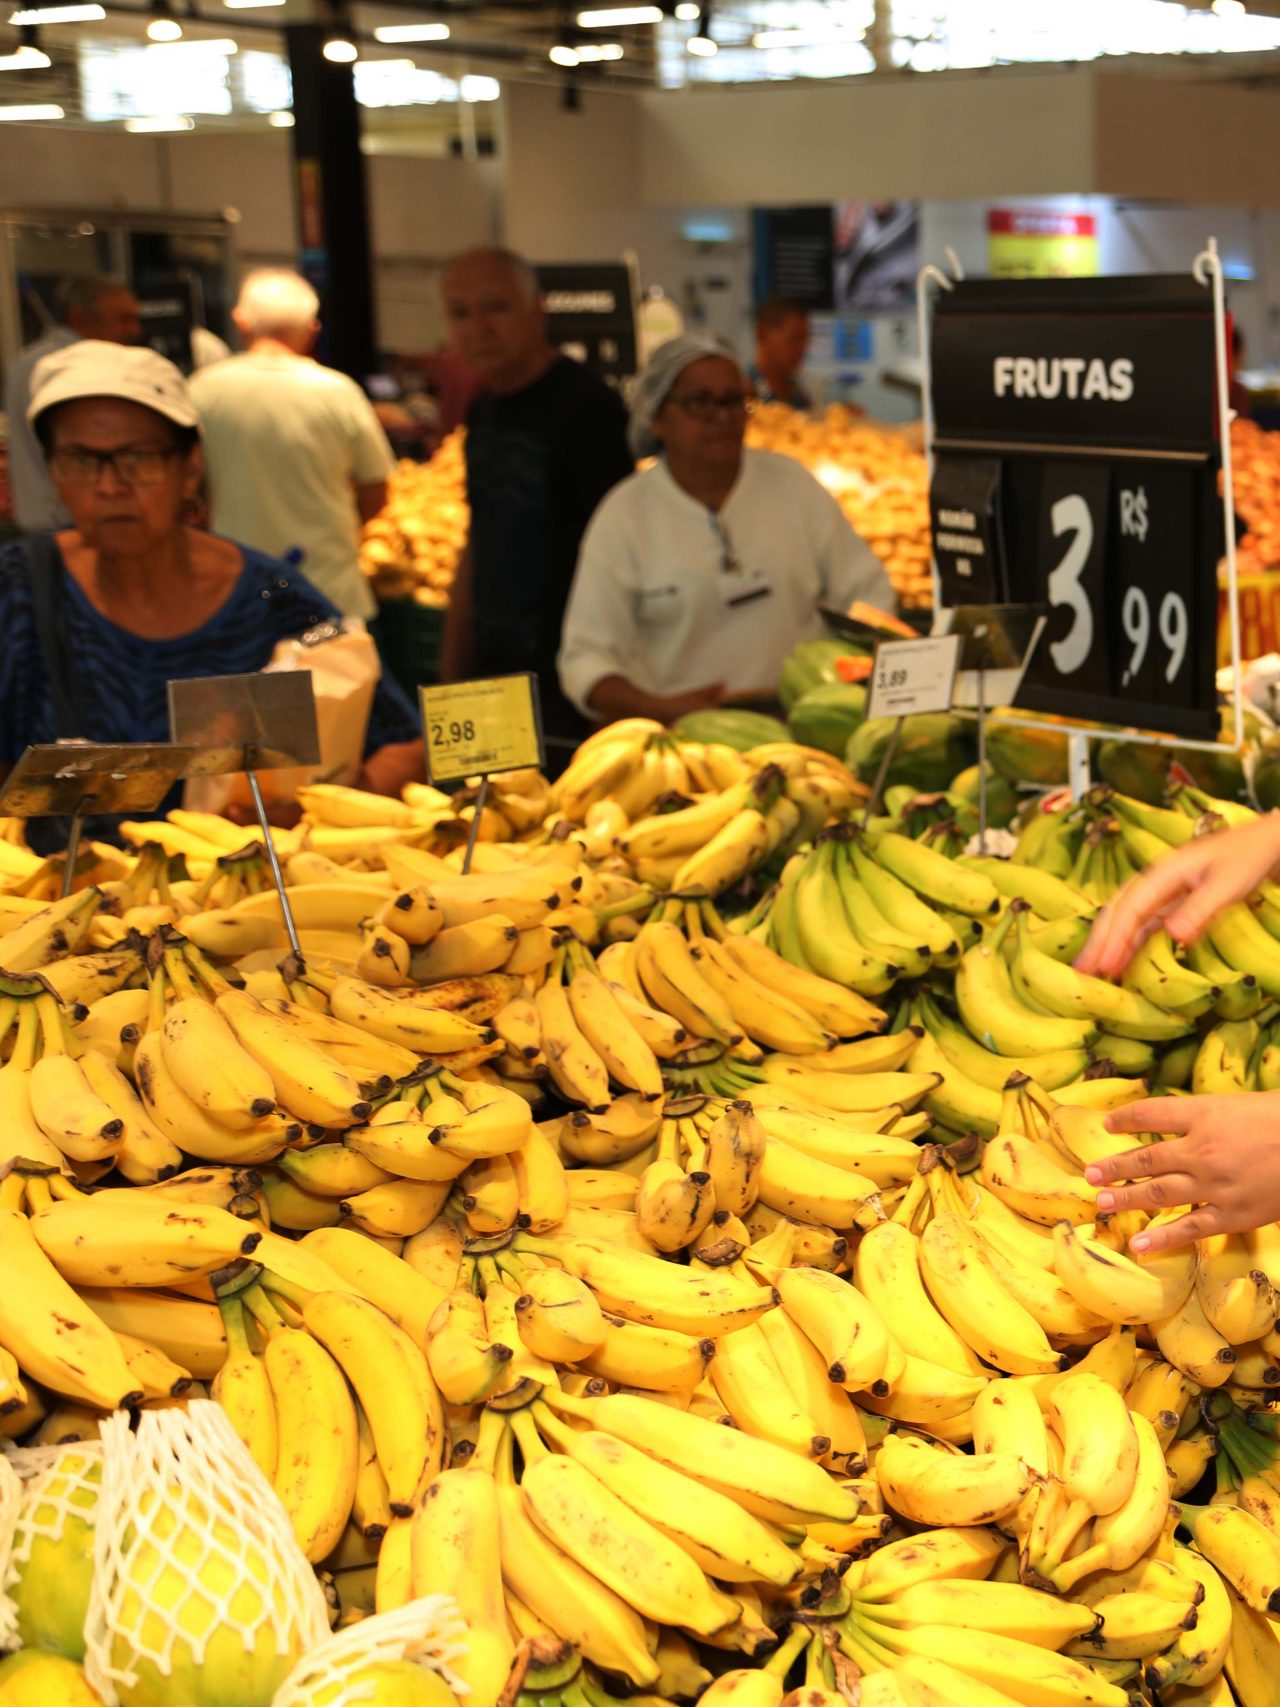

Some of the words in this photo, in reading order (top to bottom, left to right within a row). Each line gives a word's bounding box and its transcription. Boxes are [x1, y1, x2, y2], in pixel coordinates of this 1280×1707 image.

[993, 356, 1134, 401] FRUTAS
[1119, 487, 1149, 542] R$
[1048, 494, 1094, 674] 3
[431, 720, 475, 748] 2,98
